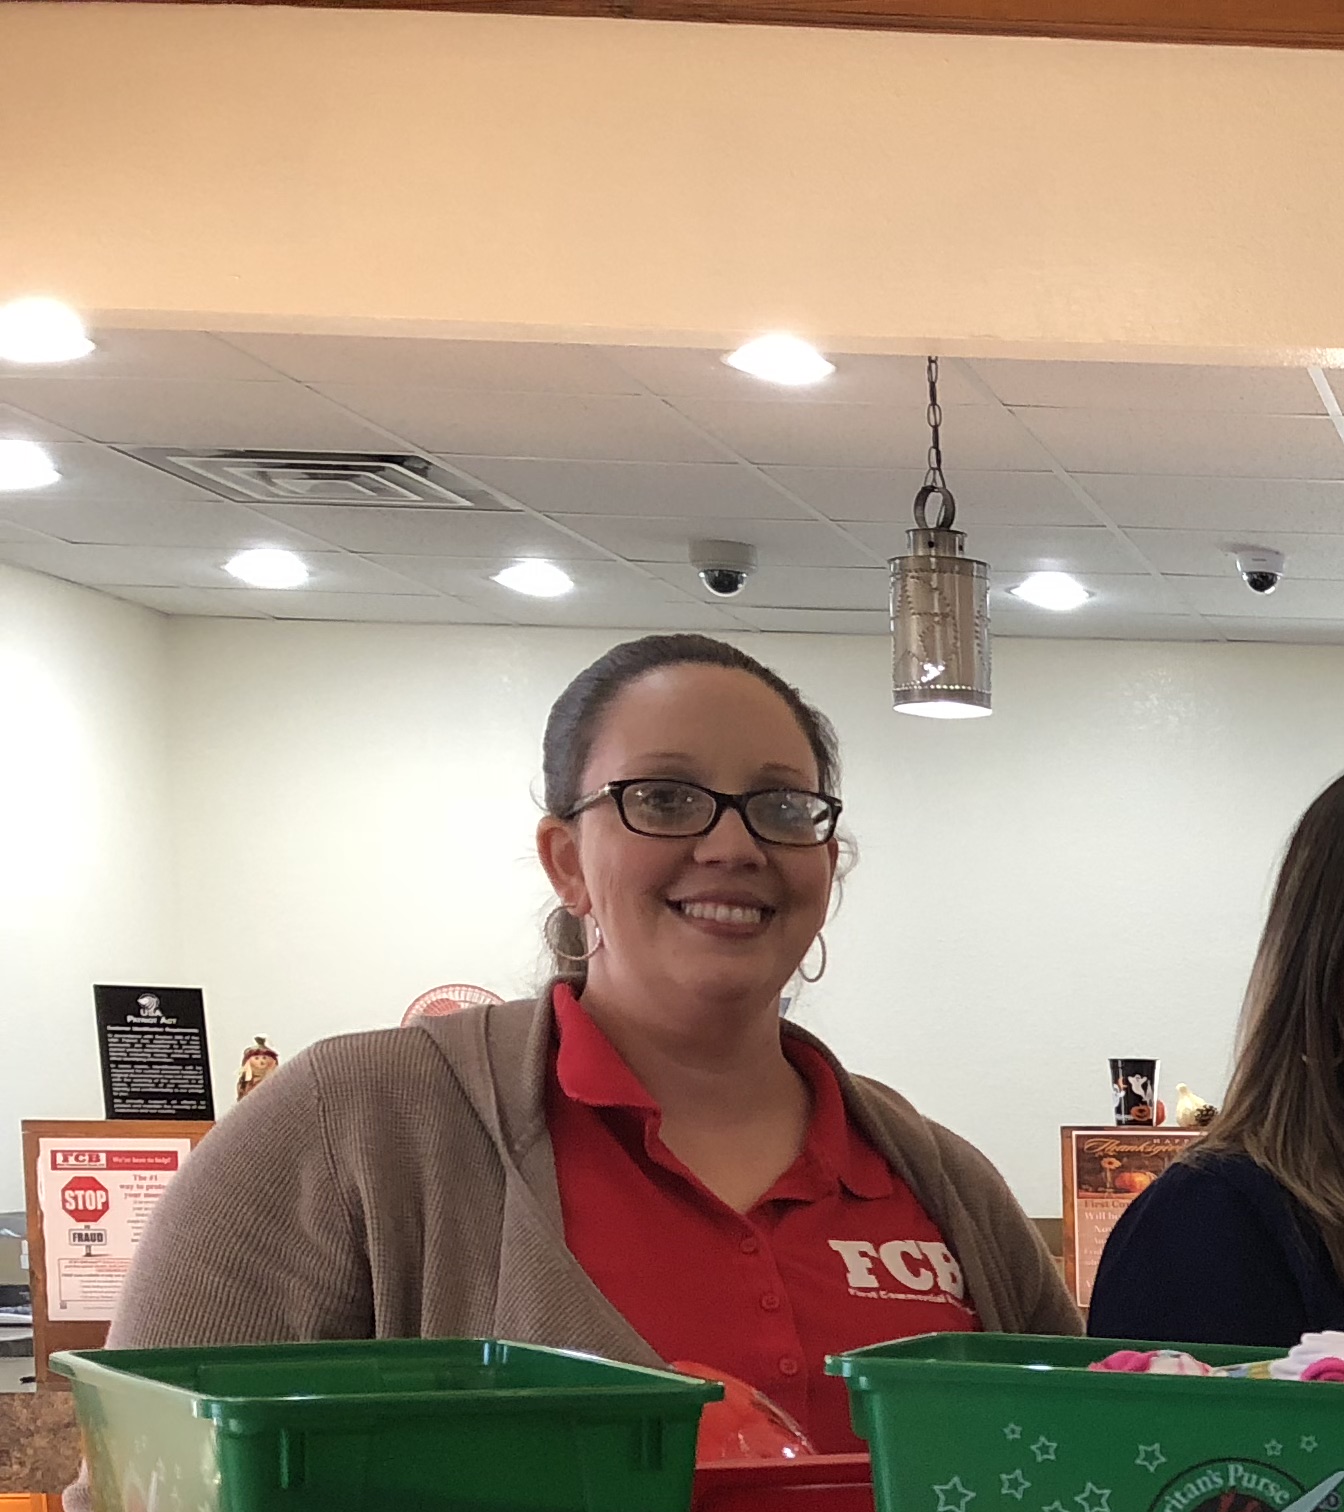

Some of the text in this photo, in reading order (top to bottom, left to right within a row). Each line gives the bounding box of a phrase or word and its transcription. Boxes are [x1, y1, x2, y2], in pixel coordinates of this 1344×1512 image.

[61, 1152, 102, 1163] FCB
[133, 1174, 147, 1182] The
[64, 1189, 107, 1211] STOP
[1085, 1200, 1109, 1208] First
[1085, 1211, 1106, 1220] Will
[1094, 1225, 1113, 1233] Nov
[72, 1232, 104, 1243] FRAUD
[827, 1240, 964, 1300] FCB
[1227, 1463, 1290, 1505] Purse
